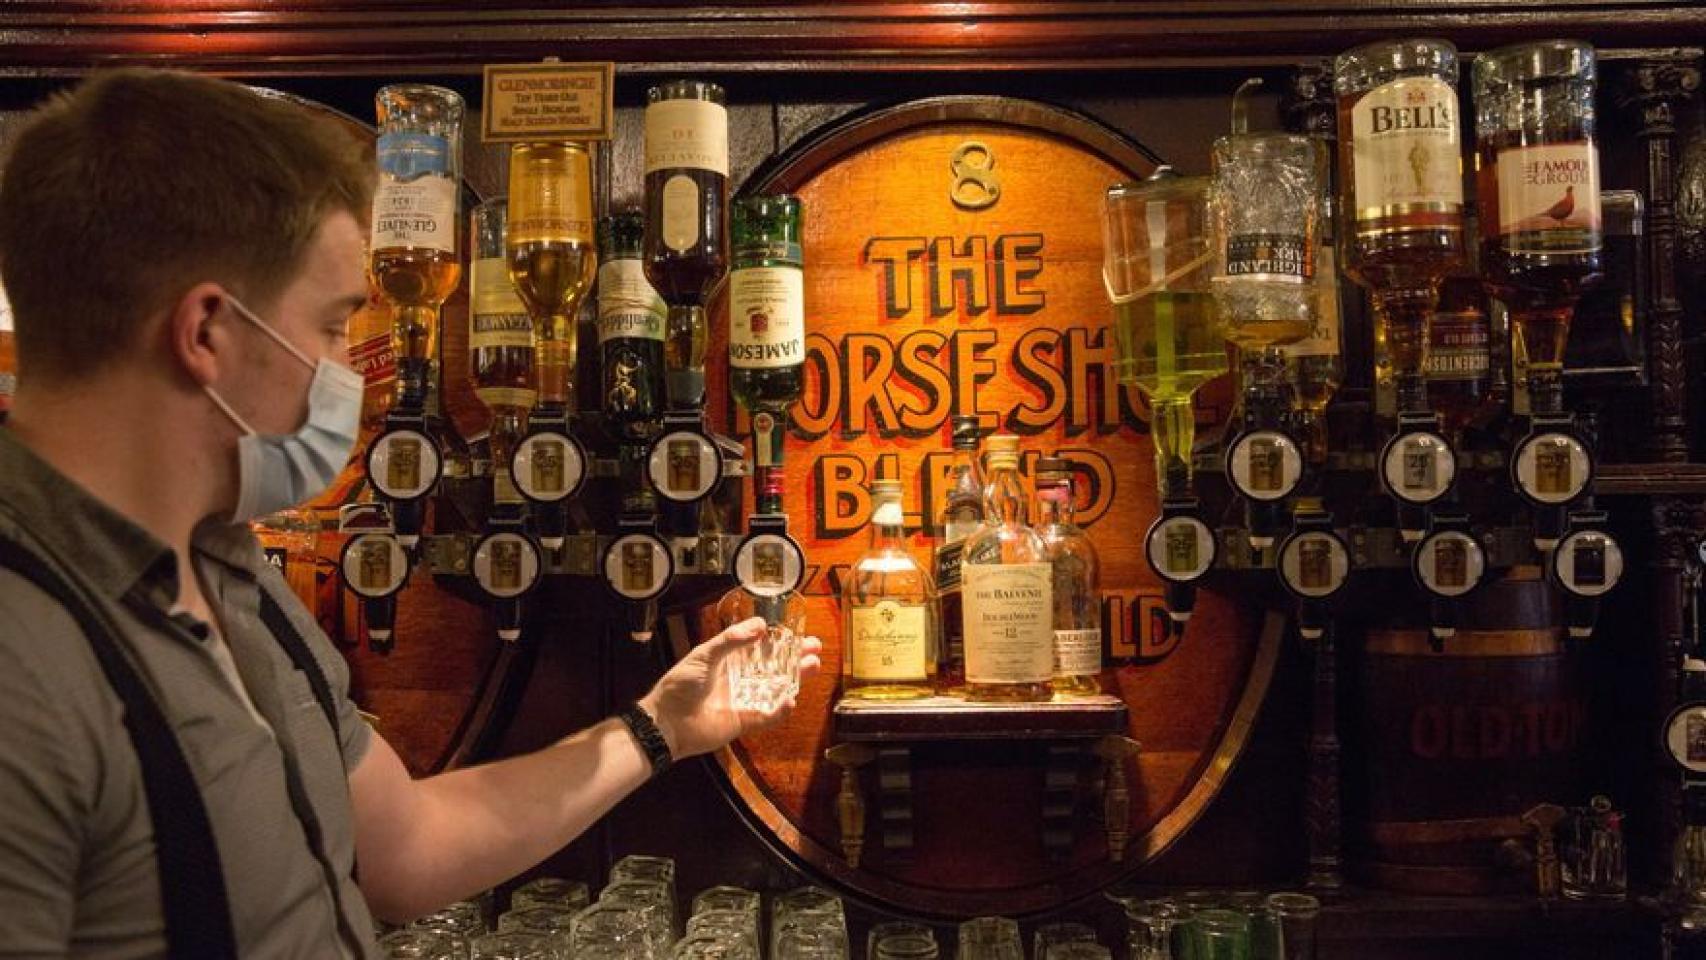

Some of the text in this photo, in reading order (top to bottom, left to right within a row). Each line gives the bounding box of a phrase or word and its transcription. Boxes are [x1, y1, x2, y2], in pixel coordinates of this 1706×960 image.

[1371, 102, 1452, 133] BELL'S
[951, 140, 1001, 213] 8
[377, 219, 437, 233] GLENLIVET
[1272, 247, 1303, 261] ARK
[862, 232, 1047, 319] THE
[1228, 260, 1303, 275] IGHLAND
